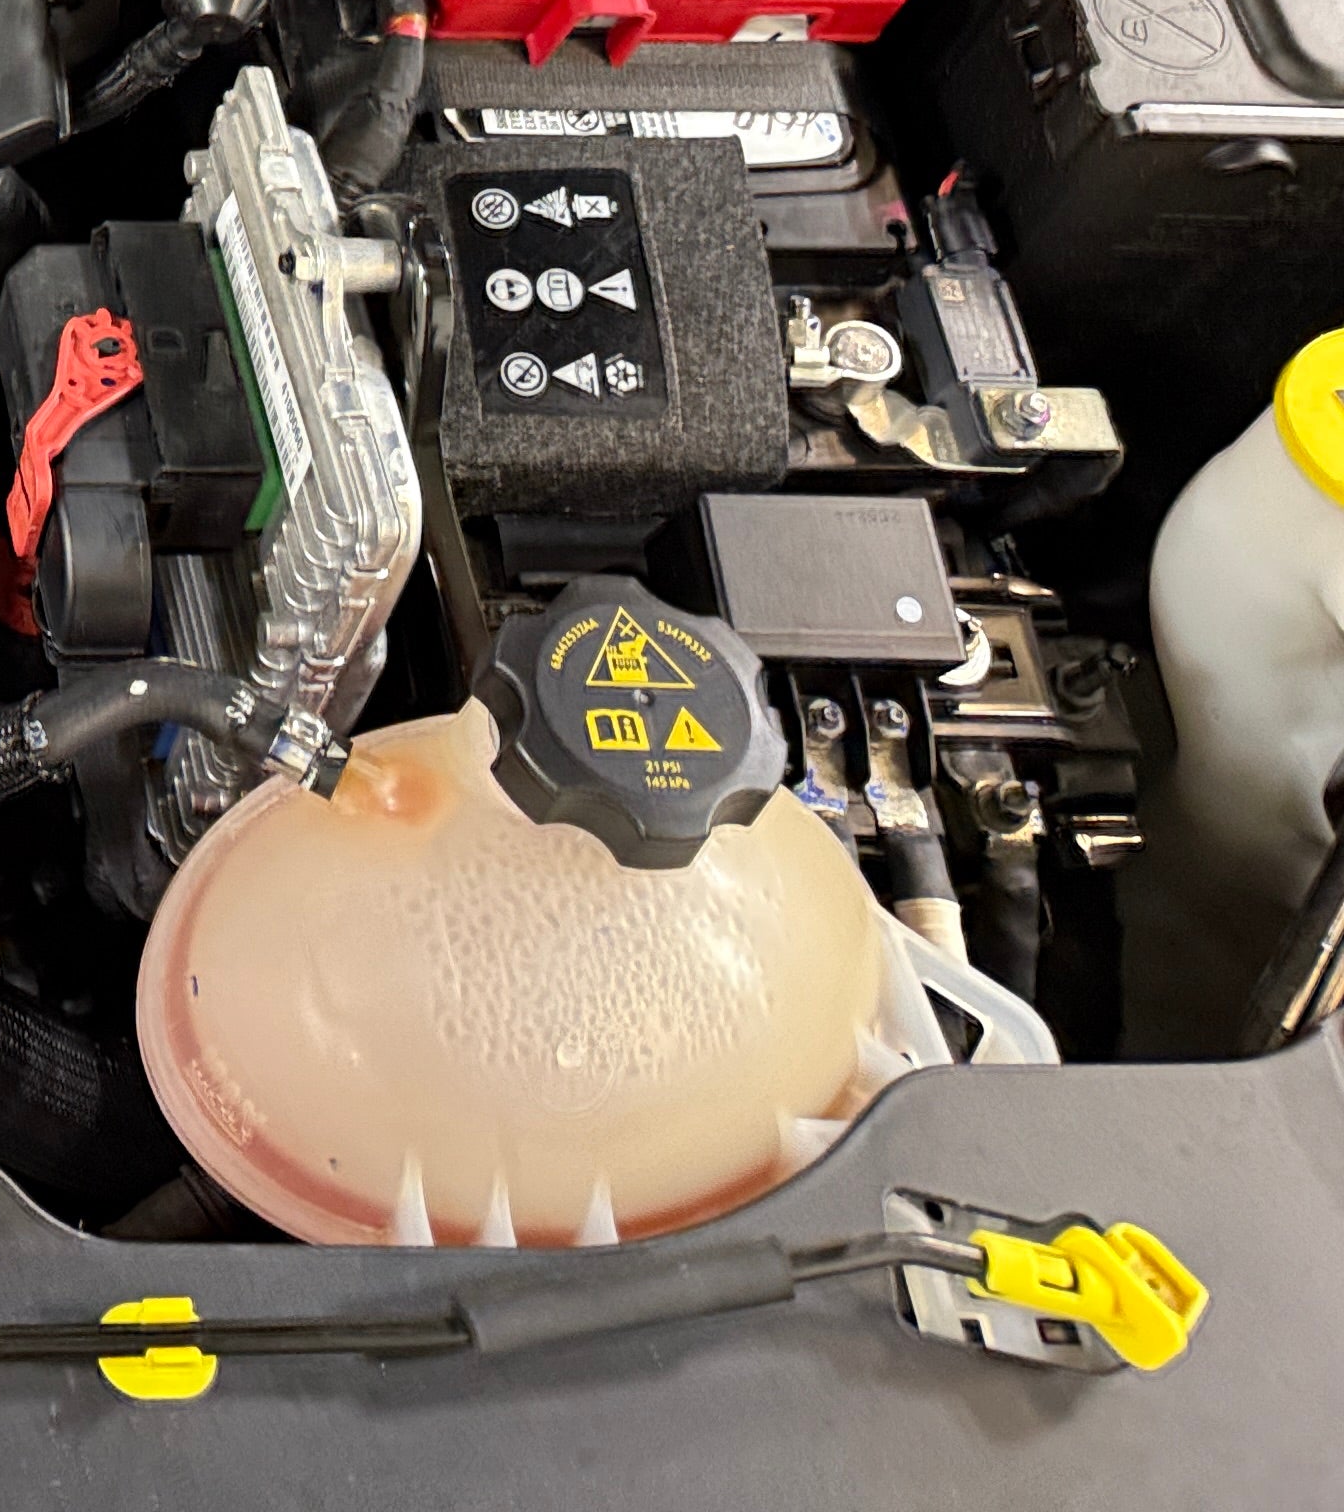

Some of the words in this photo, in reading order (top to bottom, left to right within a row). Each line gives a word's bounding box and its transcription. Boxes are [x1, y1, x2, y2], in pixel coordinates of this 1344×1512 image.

[645, 760, 660, 774] 21
[662, 761, 682, 774] PSI
[669, 776, 691, 790] kPa
